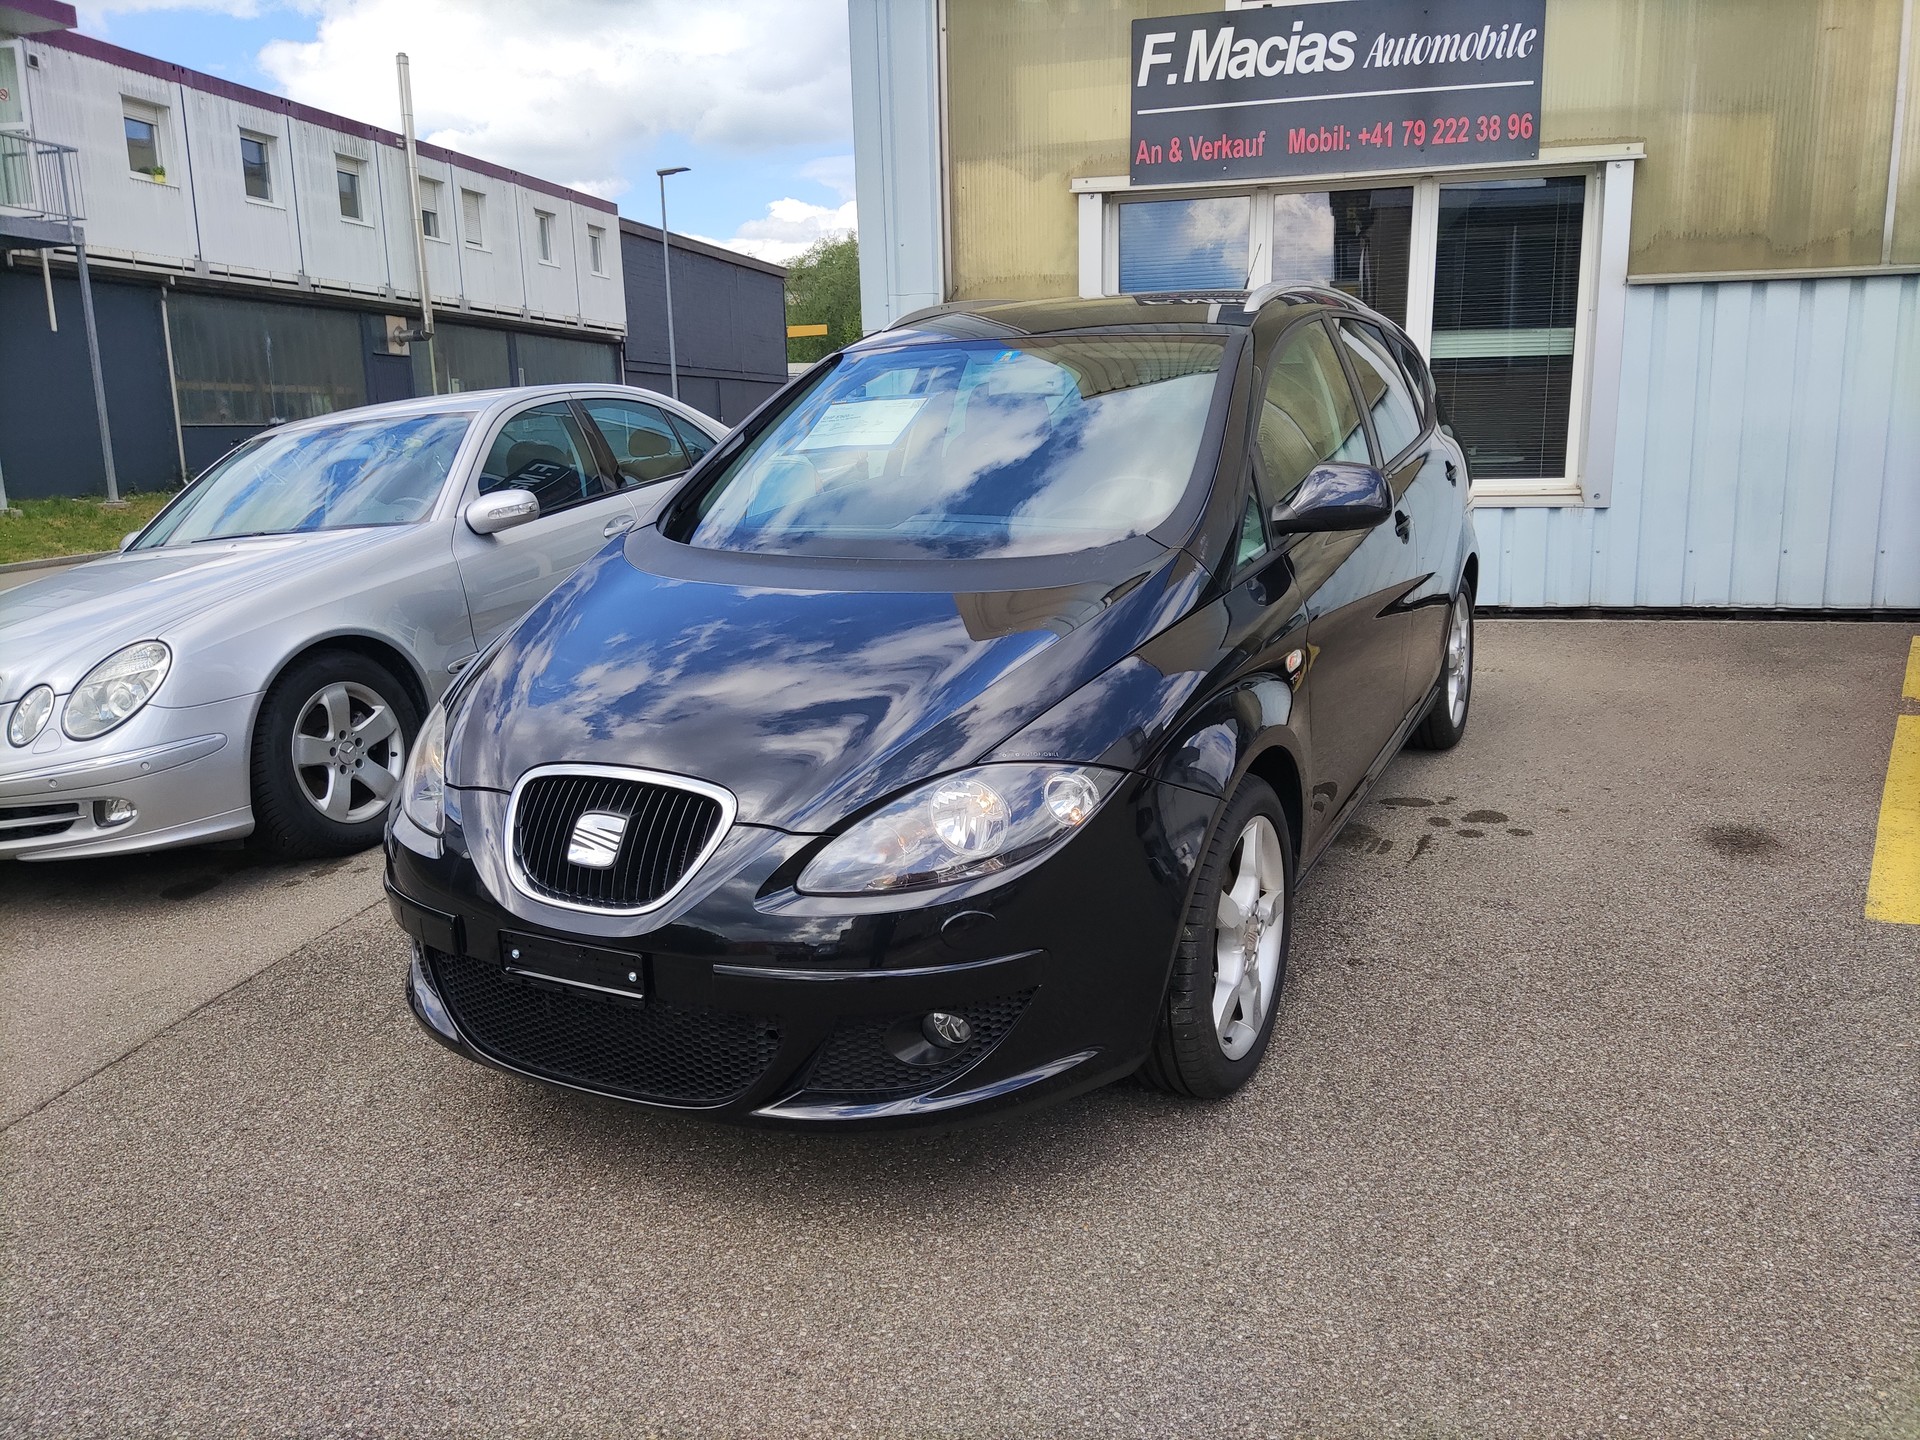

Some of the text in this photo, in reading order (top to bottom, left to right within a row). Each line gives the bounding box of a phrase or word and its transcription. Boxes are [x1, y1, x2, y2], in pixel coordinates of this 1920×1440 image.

[1362, 22, 1537, 69] Automobile
[1135, 112, 1534, 164] An & Verkauf Mobil: +41 79 222 38 96
